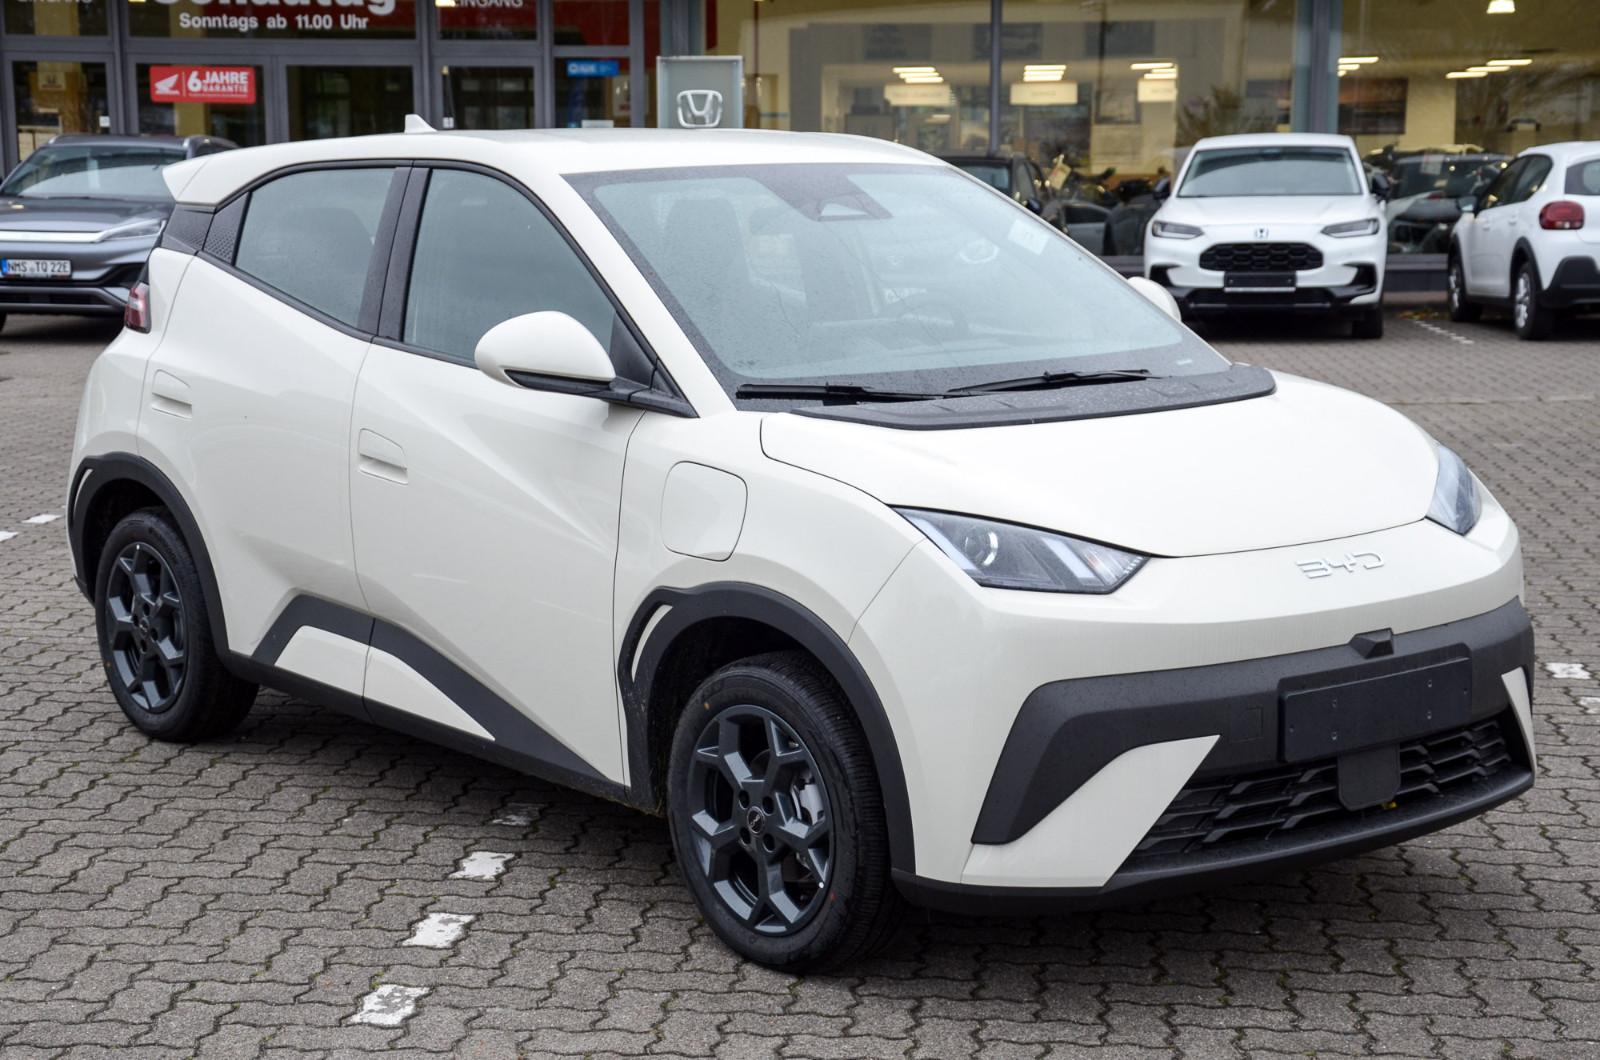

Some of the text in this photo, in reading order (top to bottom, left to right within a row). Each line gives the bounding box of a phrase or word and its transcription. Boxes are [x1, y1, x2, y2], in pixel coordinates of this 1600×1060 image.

[453, 0, 523, 8] INGANG
[179, 13, 368, 32] Sonntags ab 11.00 Uhr
[187, 70, 248, 92] 6 JAHRE
[1296, 552, 1384, 580] BYD
